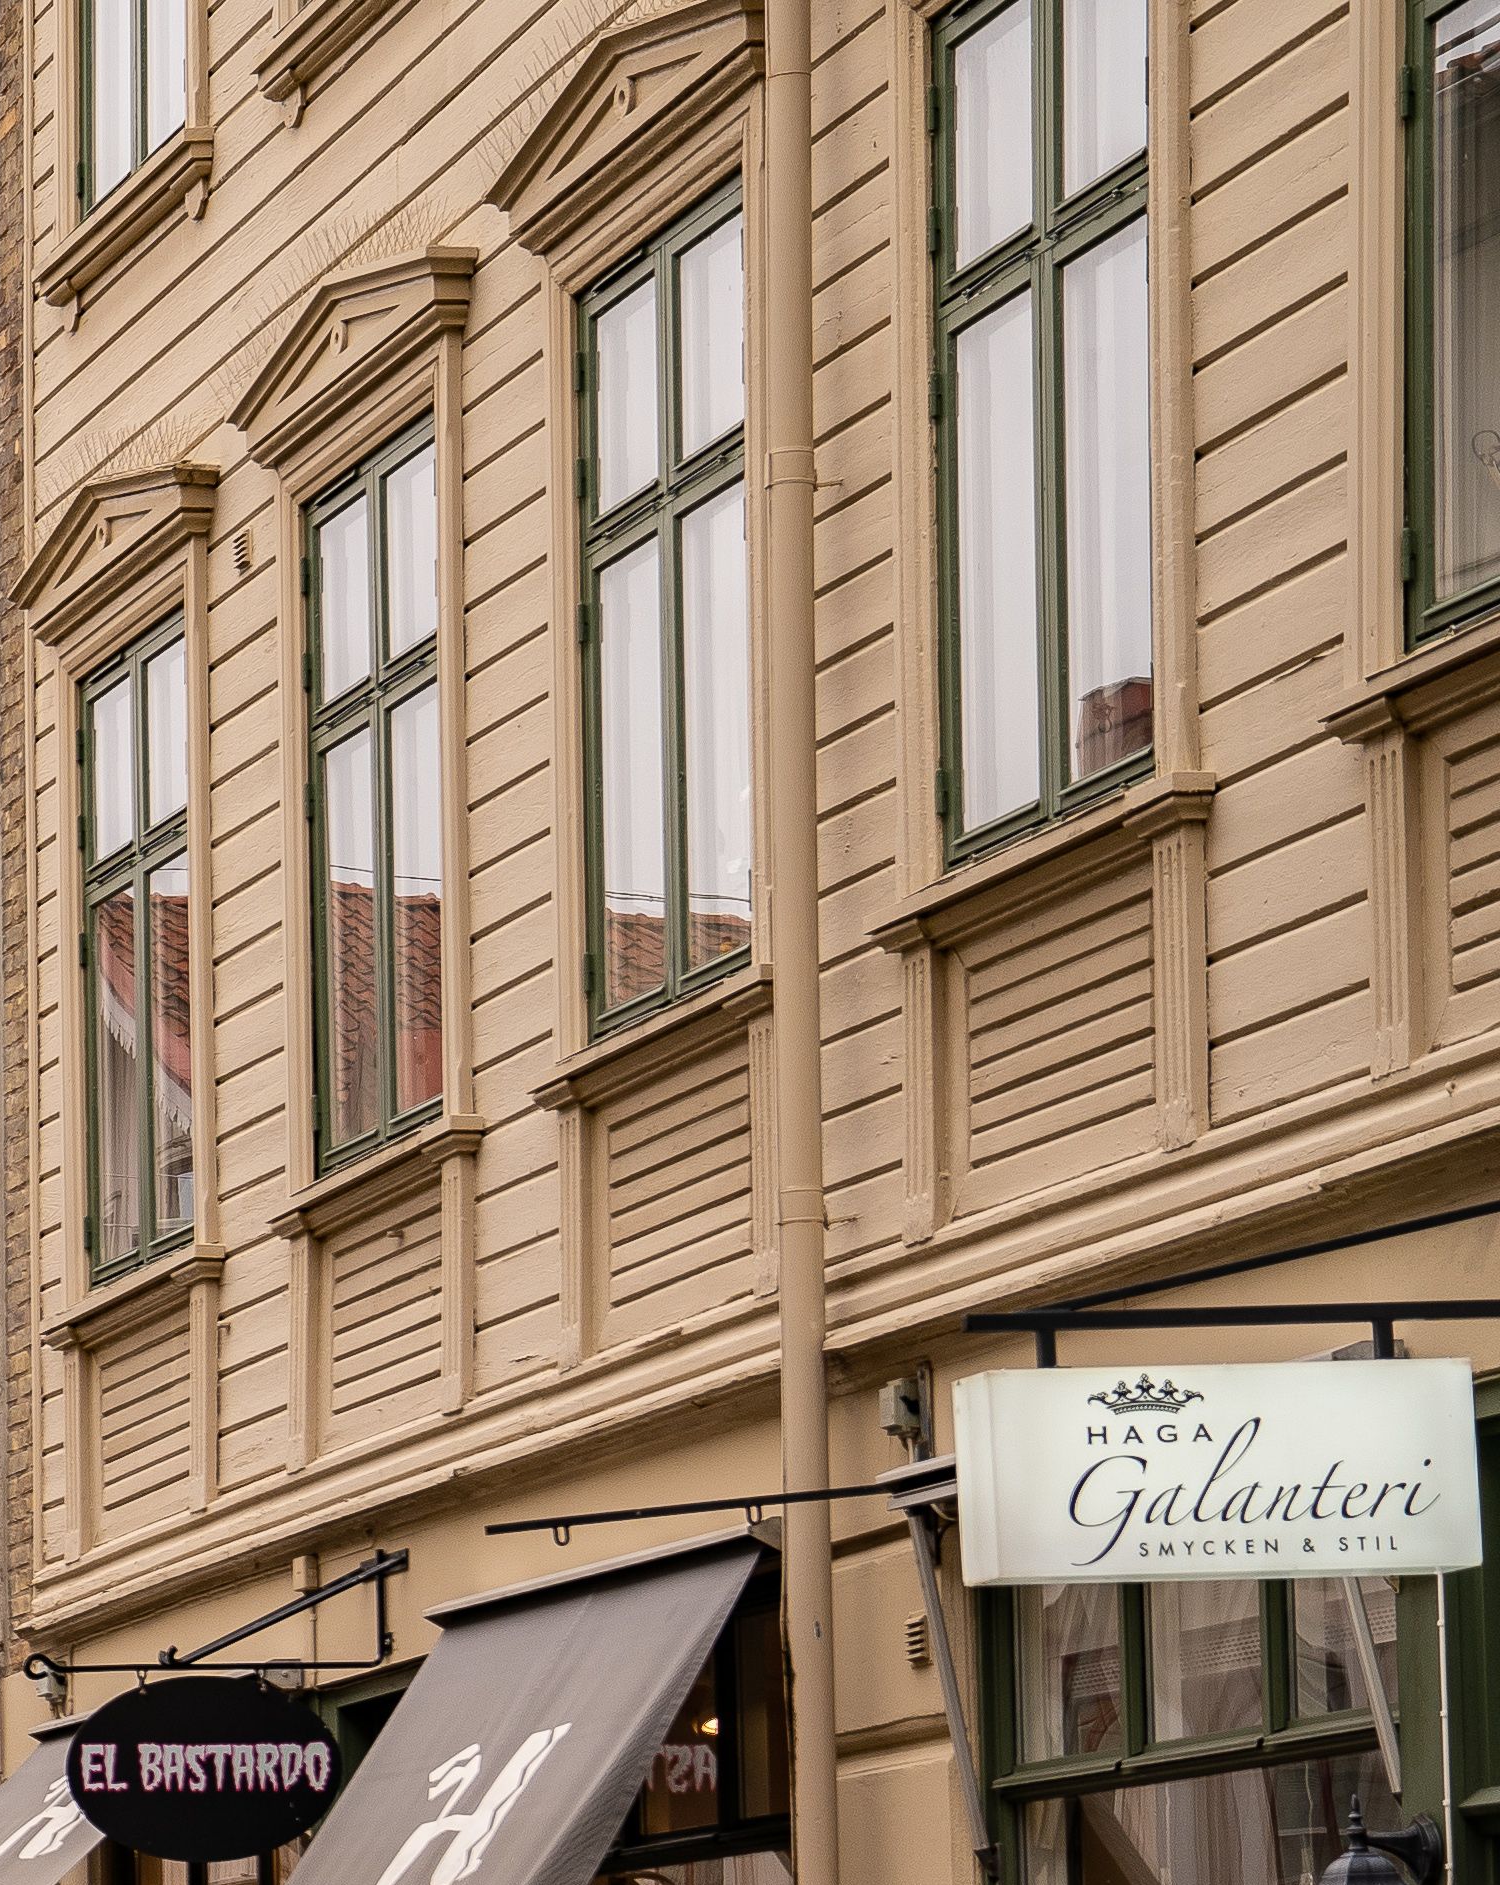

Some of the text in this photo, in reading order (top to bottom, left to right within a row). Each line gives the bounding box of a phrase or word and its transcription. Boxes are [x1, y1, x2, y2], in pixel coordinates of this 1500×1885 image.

[1086, 1422, 1214, 1446] HAGA
[1067, 1416, 1442, 1567] Galanteri
[1138, 1534, 1400, 1558] SMYCKEN & STIL
[80, 1740, 333, 1794] EL BASTARDO
